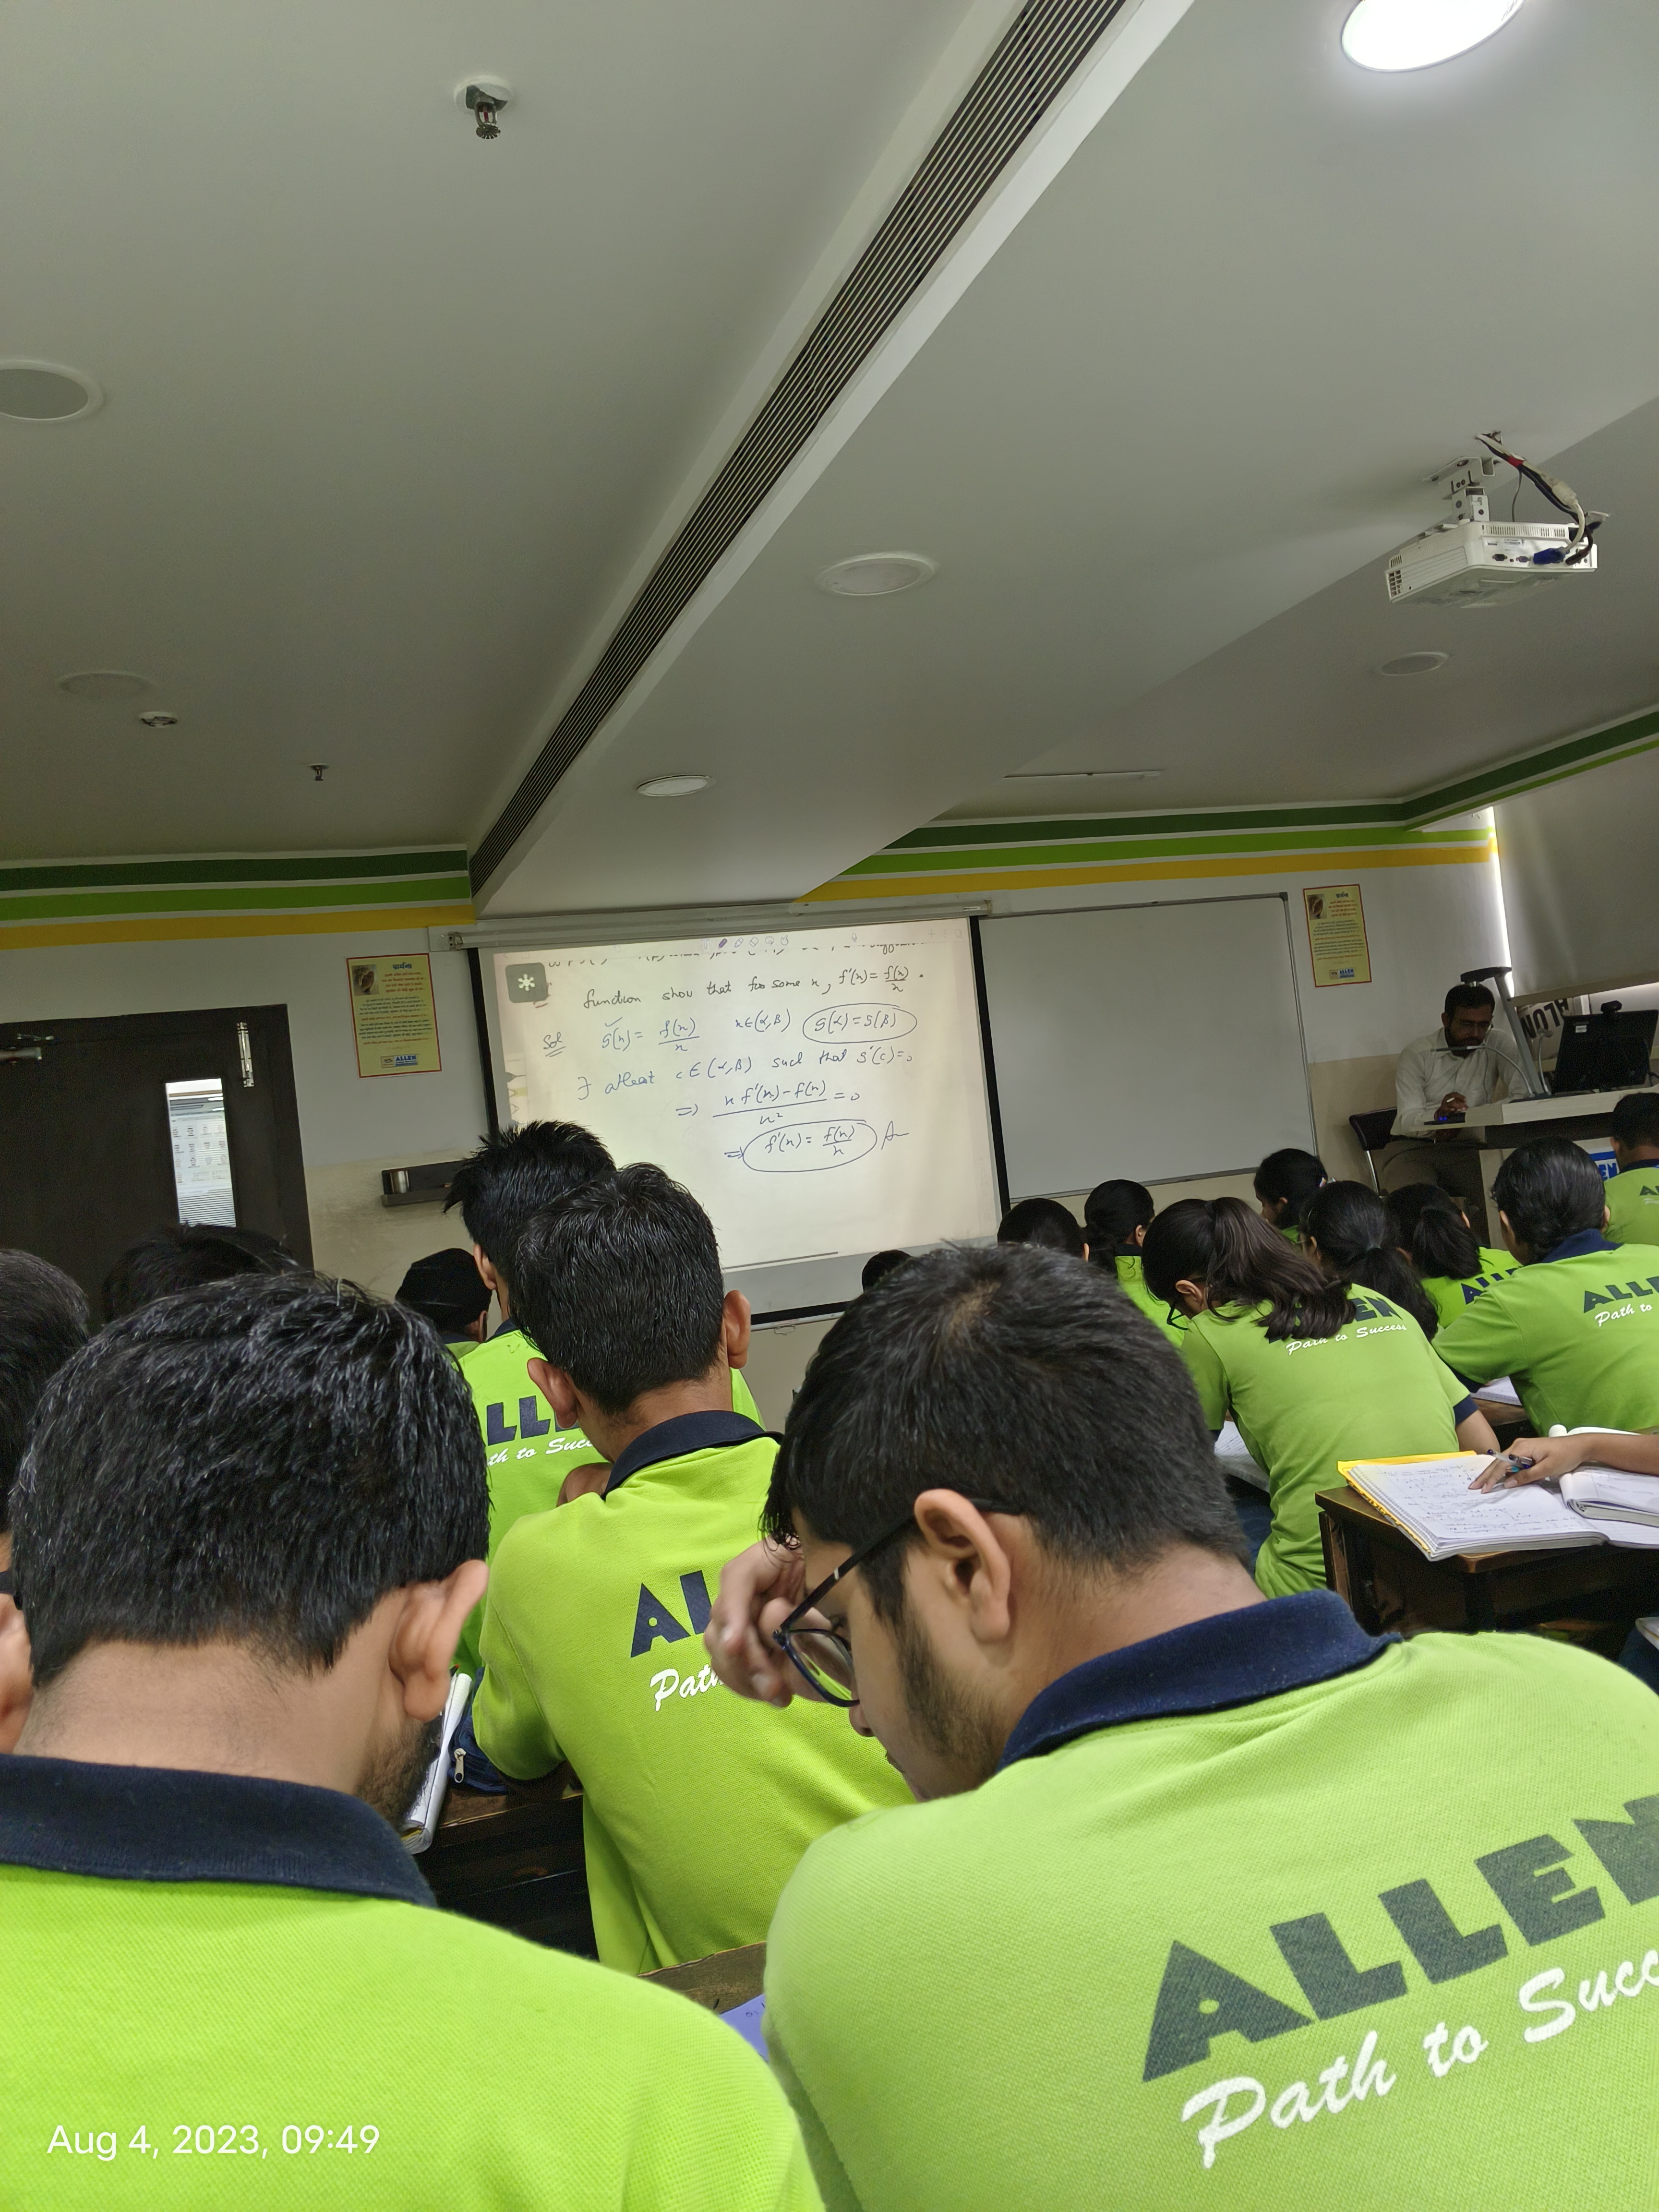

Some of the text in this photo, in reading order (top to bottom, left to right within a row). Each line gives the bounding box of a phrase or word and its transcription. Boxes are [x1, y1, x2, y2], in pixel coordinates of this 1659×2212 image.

[583, 988, 642, 1009] function
[707, 980, 732, 995] that
[771, 980, 800, 988] some
[1595, 1304, 1653, 1327] Path to
[1356, 1324, 1407, 1338] Success
[516, 1447, 537, 1460] to
[1181, 2030, 1396, 2169] Path
[1423, 2022, 1489, 2078] to
